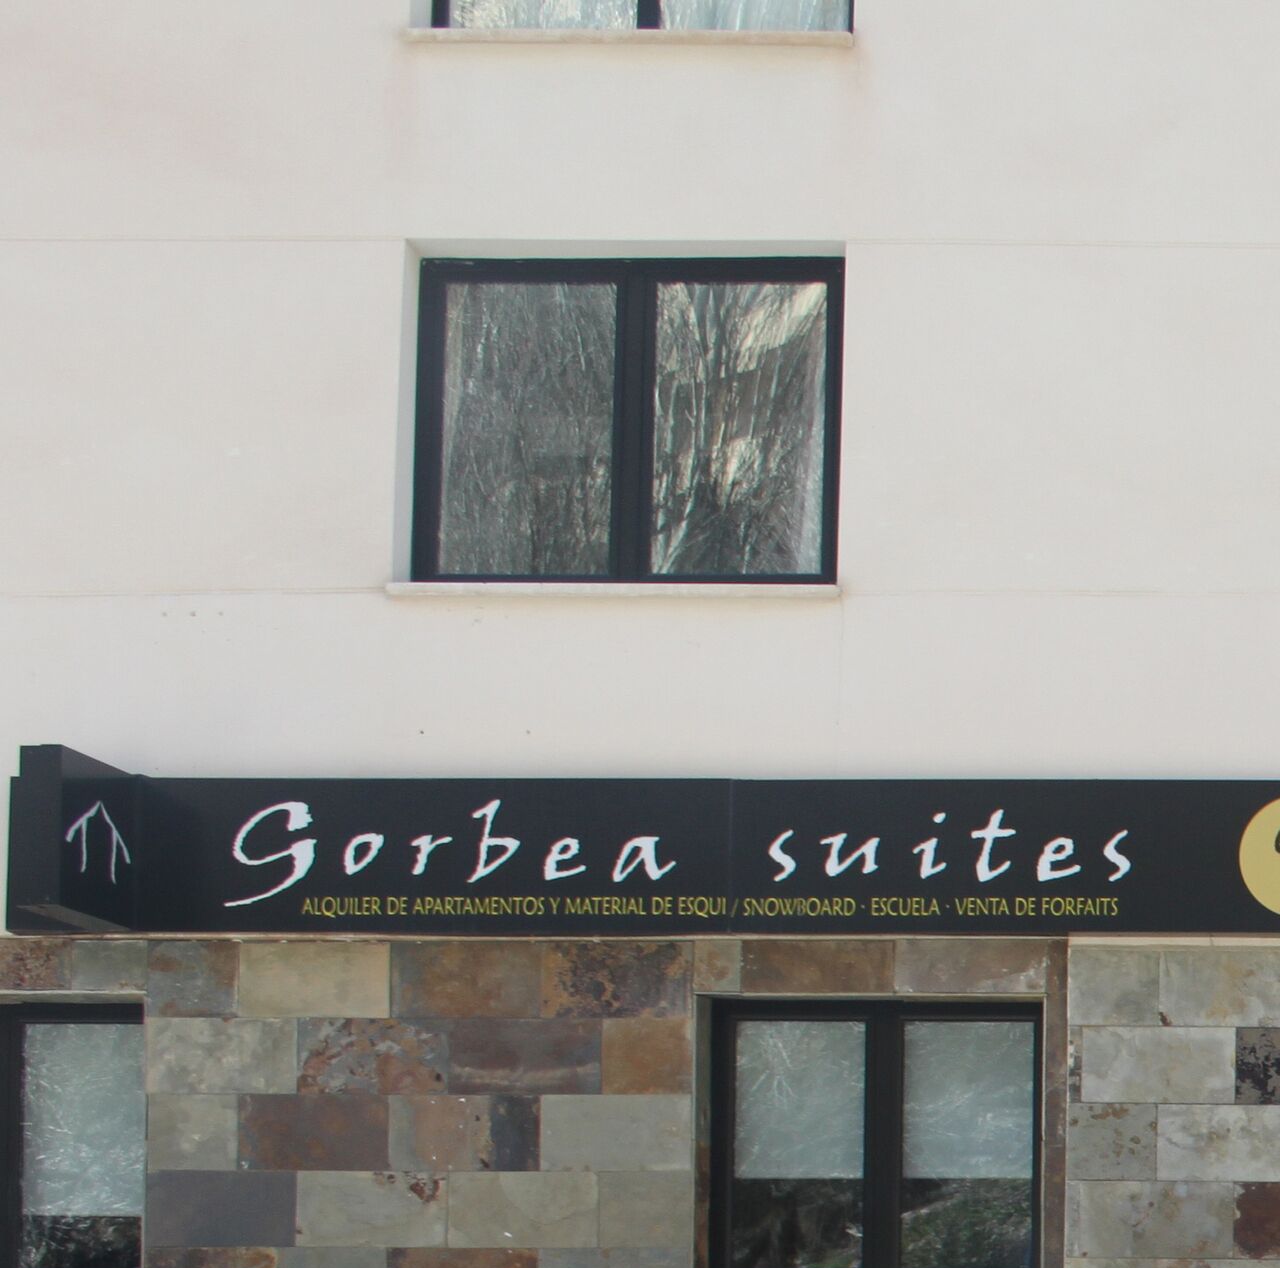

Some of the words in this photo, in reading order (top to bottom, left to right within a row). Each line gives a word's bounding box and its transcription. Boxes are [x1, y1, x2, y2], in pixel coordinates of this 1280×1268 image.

[224, 799, 678, 907] Gorbea
[768, 808, 1132, 883] suites
[302, 896, 382, 918] ALQUILER
[386, 897, 408, 916] DE
[412, 896, 545, 916] APARTAMENTOS
[549, 897, 561, 916] Y
[564, 896, 647, 916] MATERIAL
[651, 896, 673, 916] DE
[677, 896, 727, 918] ESQUI
[742, 896, 856, 917] SNOWBOARD
[870, 897, 941, 917] ESCUELA
[955, 897, 1010, 917] VENTA
[1015, 897, 1036, 916] DE
[1042, 897, 1119, 917] FORFAITS
